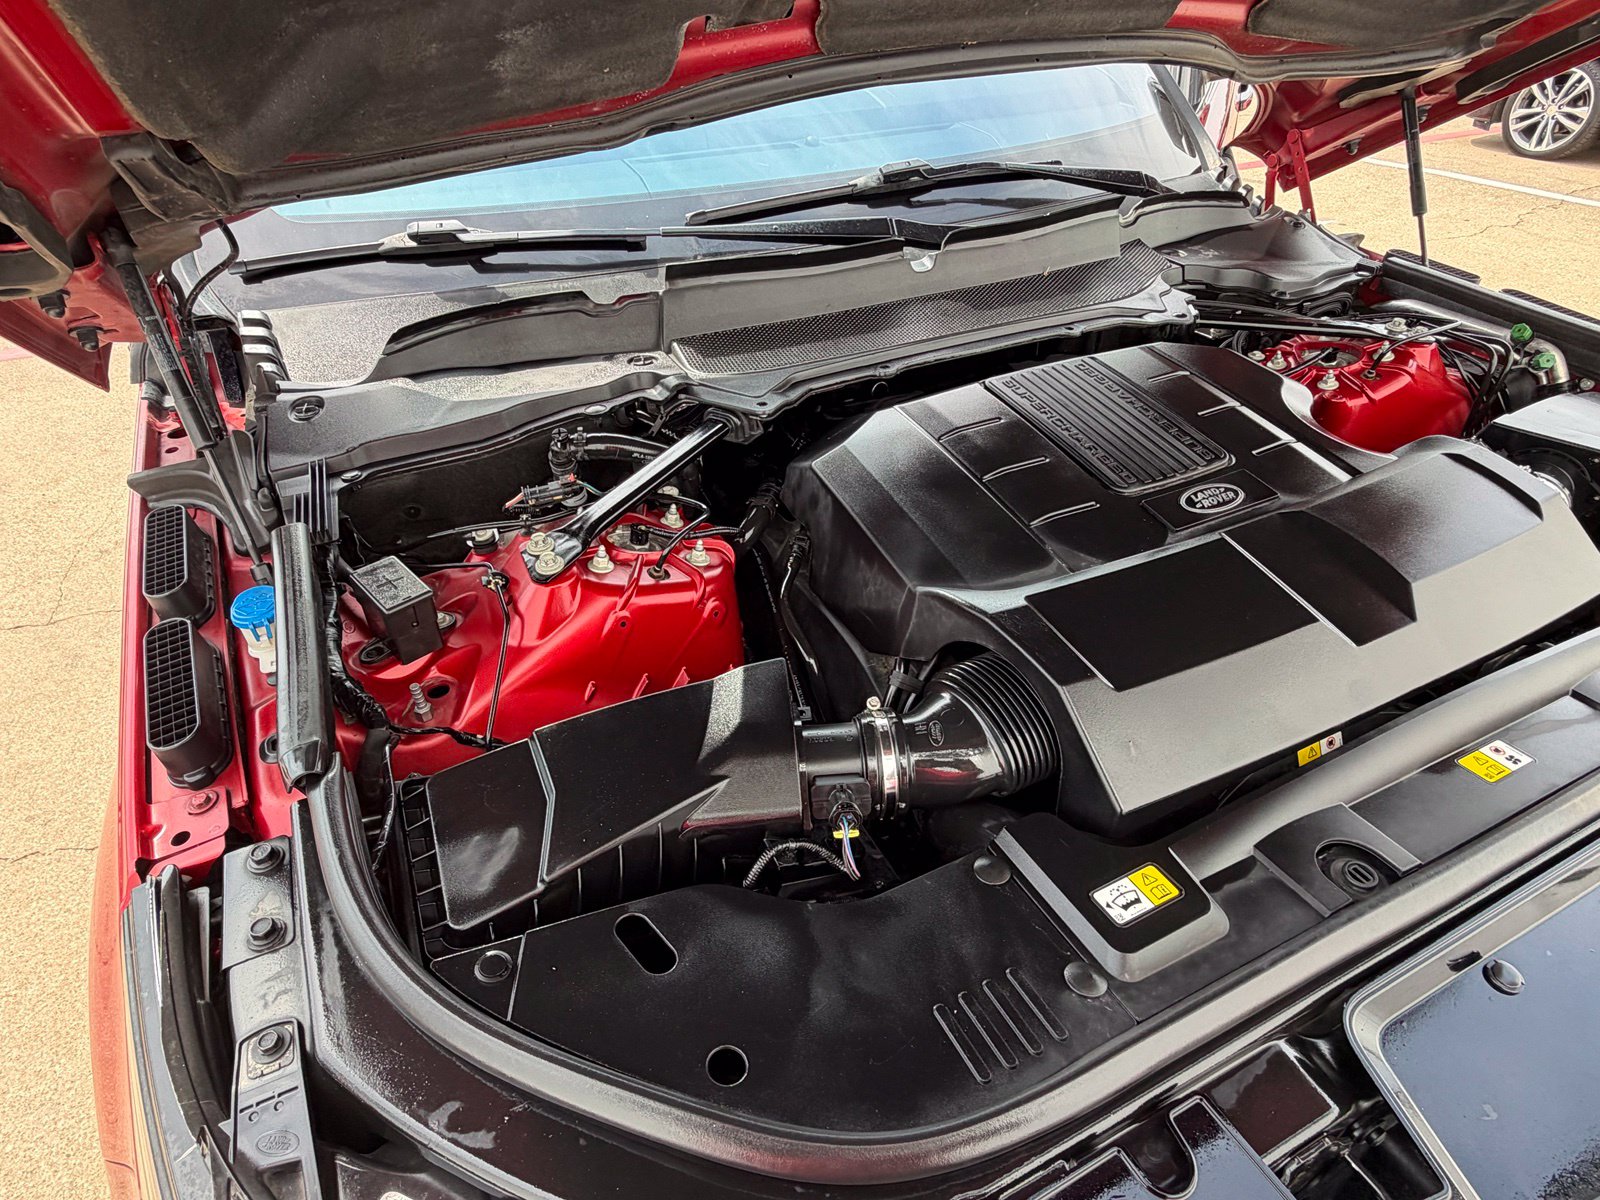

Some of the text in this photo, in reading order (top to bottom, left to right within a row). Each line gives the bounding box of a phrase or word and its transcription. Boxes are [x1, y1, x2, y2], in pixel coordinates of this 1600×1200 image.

[1001, 377, 1139, 485] SUPERCHARGED
[1073, 361, 1216, 460] SUPERCHARGED
[1190, 488, 1219, 502] LAND
[1201, 491, 1236, 508] ROVER
